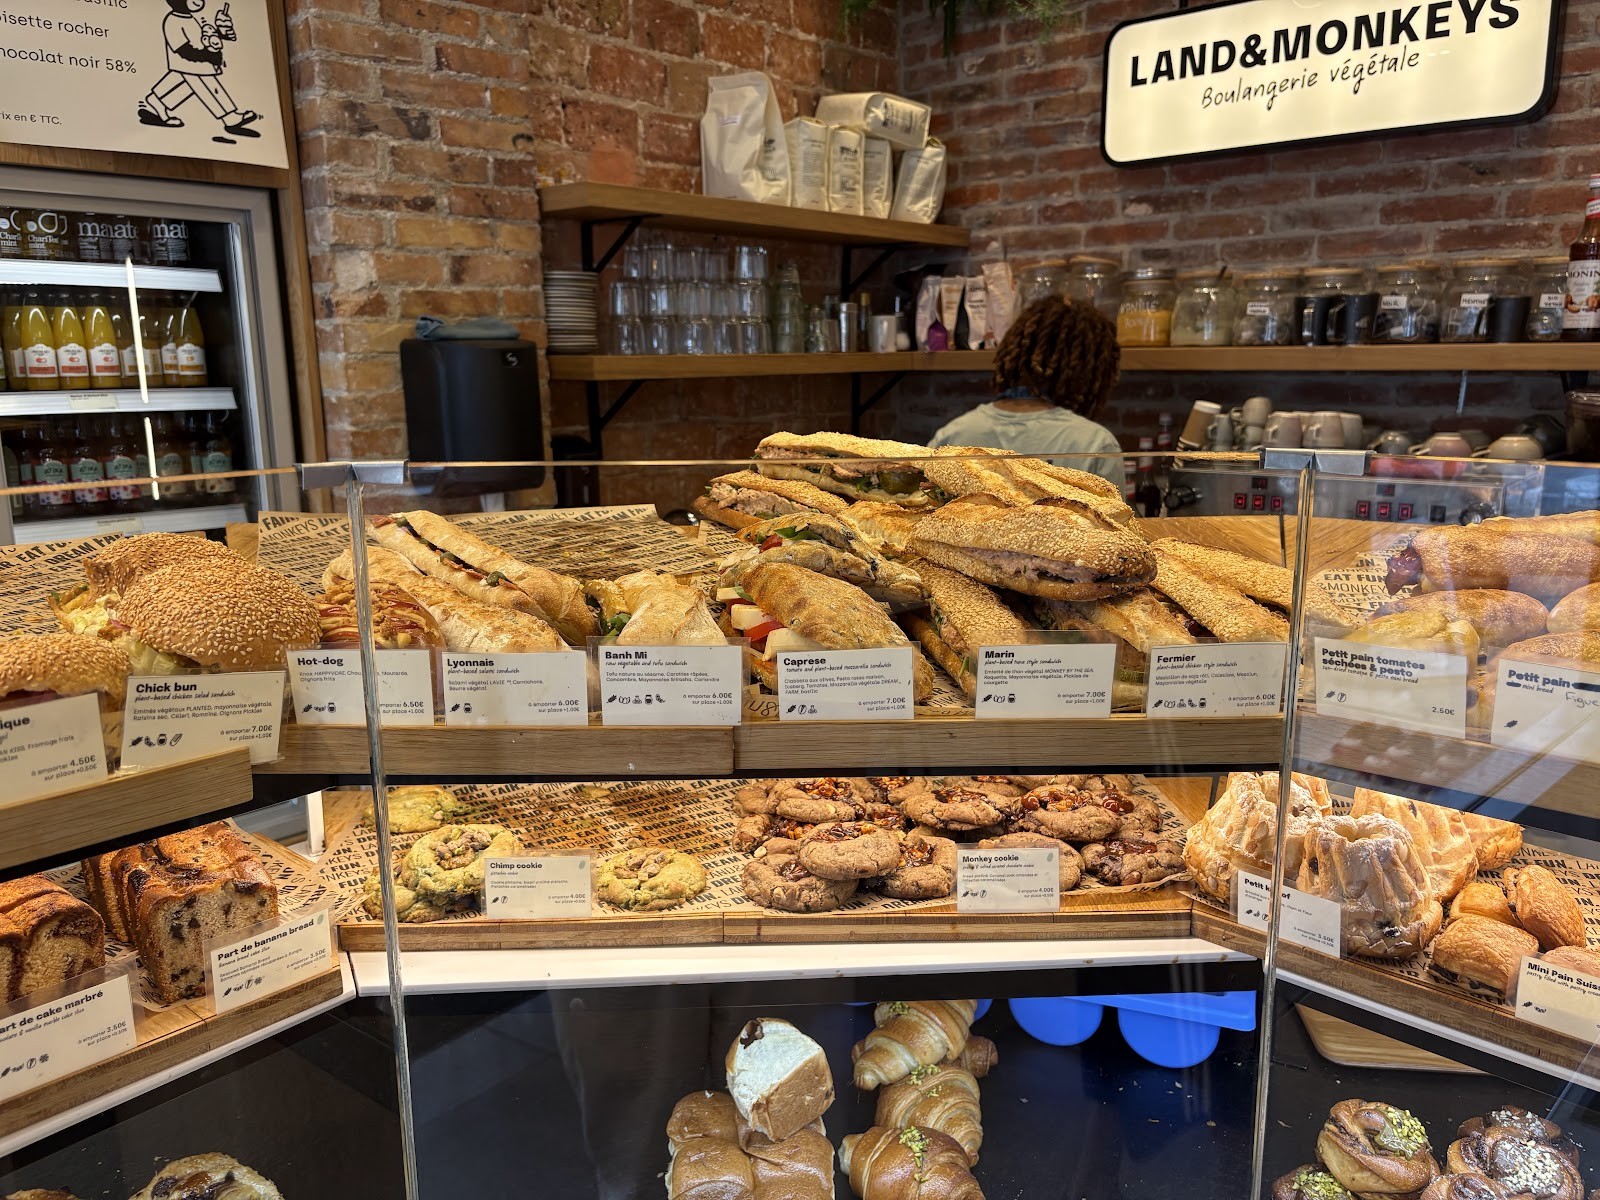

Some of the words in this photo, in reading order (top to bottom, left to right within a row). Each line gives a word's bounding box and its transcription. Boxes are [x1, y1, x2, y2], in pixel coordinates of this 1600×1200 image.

[58, 23, 109, 37] rocher
[1130, 0, 1520, 87] LAND&MONKEYS
[69, 56, 100, 68] noir
[105, 58, 136, 73] 58%
[1202, 68, 1318, 110] Boulangerie
[1330, 46, 1420, 94] végétale
[14, 113, 27, 122] en
[41, 115, 62, 125] TTC.
[16, 546, 46, 563] EAT
[45, 542, 97, 565] DREAM
[605, 651, 632, 659] Banh
[634, 651, 647, 659] Mi
[1157, 654, 1196, 663] Fermier
[1322, 648, 1348, 659] Petit
[1351, 653, 1374, 663] pain
[1376, 656, 1425, 670] tomates
[297, 657, 343, 666] Hot-dog
[447, 659, 494, 668] Lyonnais
[783, 657, 826, 667] Caprese
[1322, 657, 1366, 670] séchées
[1370, 664, 1377, 672] &
[1380, 667, 1413, 677] pesto
[815, 664, 843, 672] plant-based
[1508, 669, 1539, 682] Petit
[1542, 678, 1571, 688] pain
[136, 683, 171, 693] Chick
[174, 682, 197, 691] bun
[1536, 685, 1554, 694] bread
[135, 693, 170, 702] plant-based
[1432, 706, 1455, 716] 2.50€
[27, 739, 57, 750] Fromage
[38, 764, 68, 775] emporter
[70, 755, 96, 766] 4.50€
[56, 769, 75, 779] place
[549, 804, 572, 812] EAT
[625, 806, 671, 818] DREAM
[707, 792, 728, 800] EAT
[563, 816, 585, 824] EAT
[641, 817, 687, 831] DREAM
[659, 830, 705, 844] DREAM
[331, 862, 366, 872] FUN.
[490, 862, 514, 870] Chimp
[1245, 878, 1264, 889] Petit
[218, 948, 238, 961] Part
[241, 945, 252, 953] de
[255, 931, 287, 947] banana
[289, 919, 314, 934] bread
[1528, 962, 1550, 974] Mini
[1551, 970, 1573, 983] Pain
[1527, 971, 1542, 980] pastry
[1570, 985, 1586, 994] pastry
[0, 1023, 16, 1034] art
[19, 1017, 34, 1026] de
[36, 1007, 62, 1020] cake
[64, 990, 103, 1010] marbré
[107, 1020, 127, 1033] 3.50€
